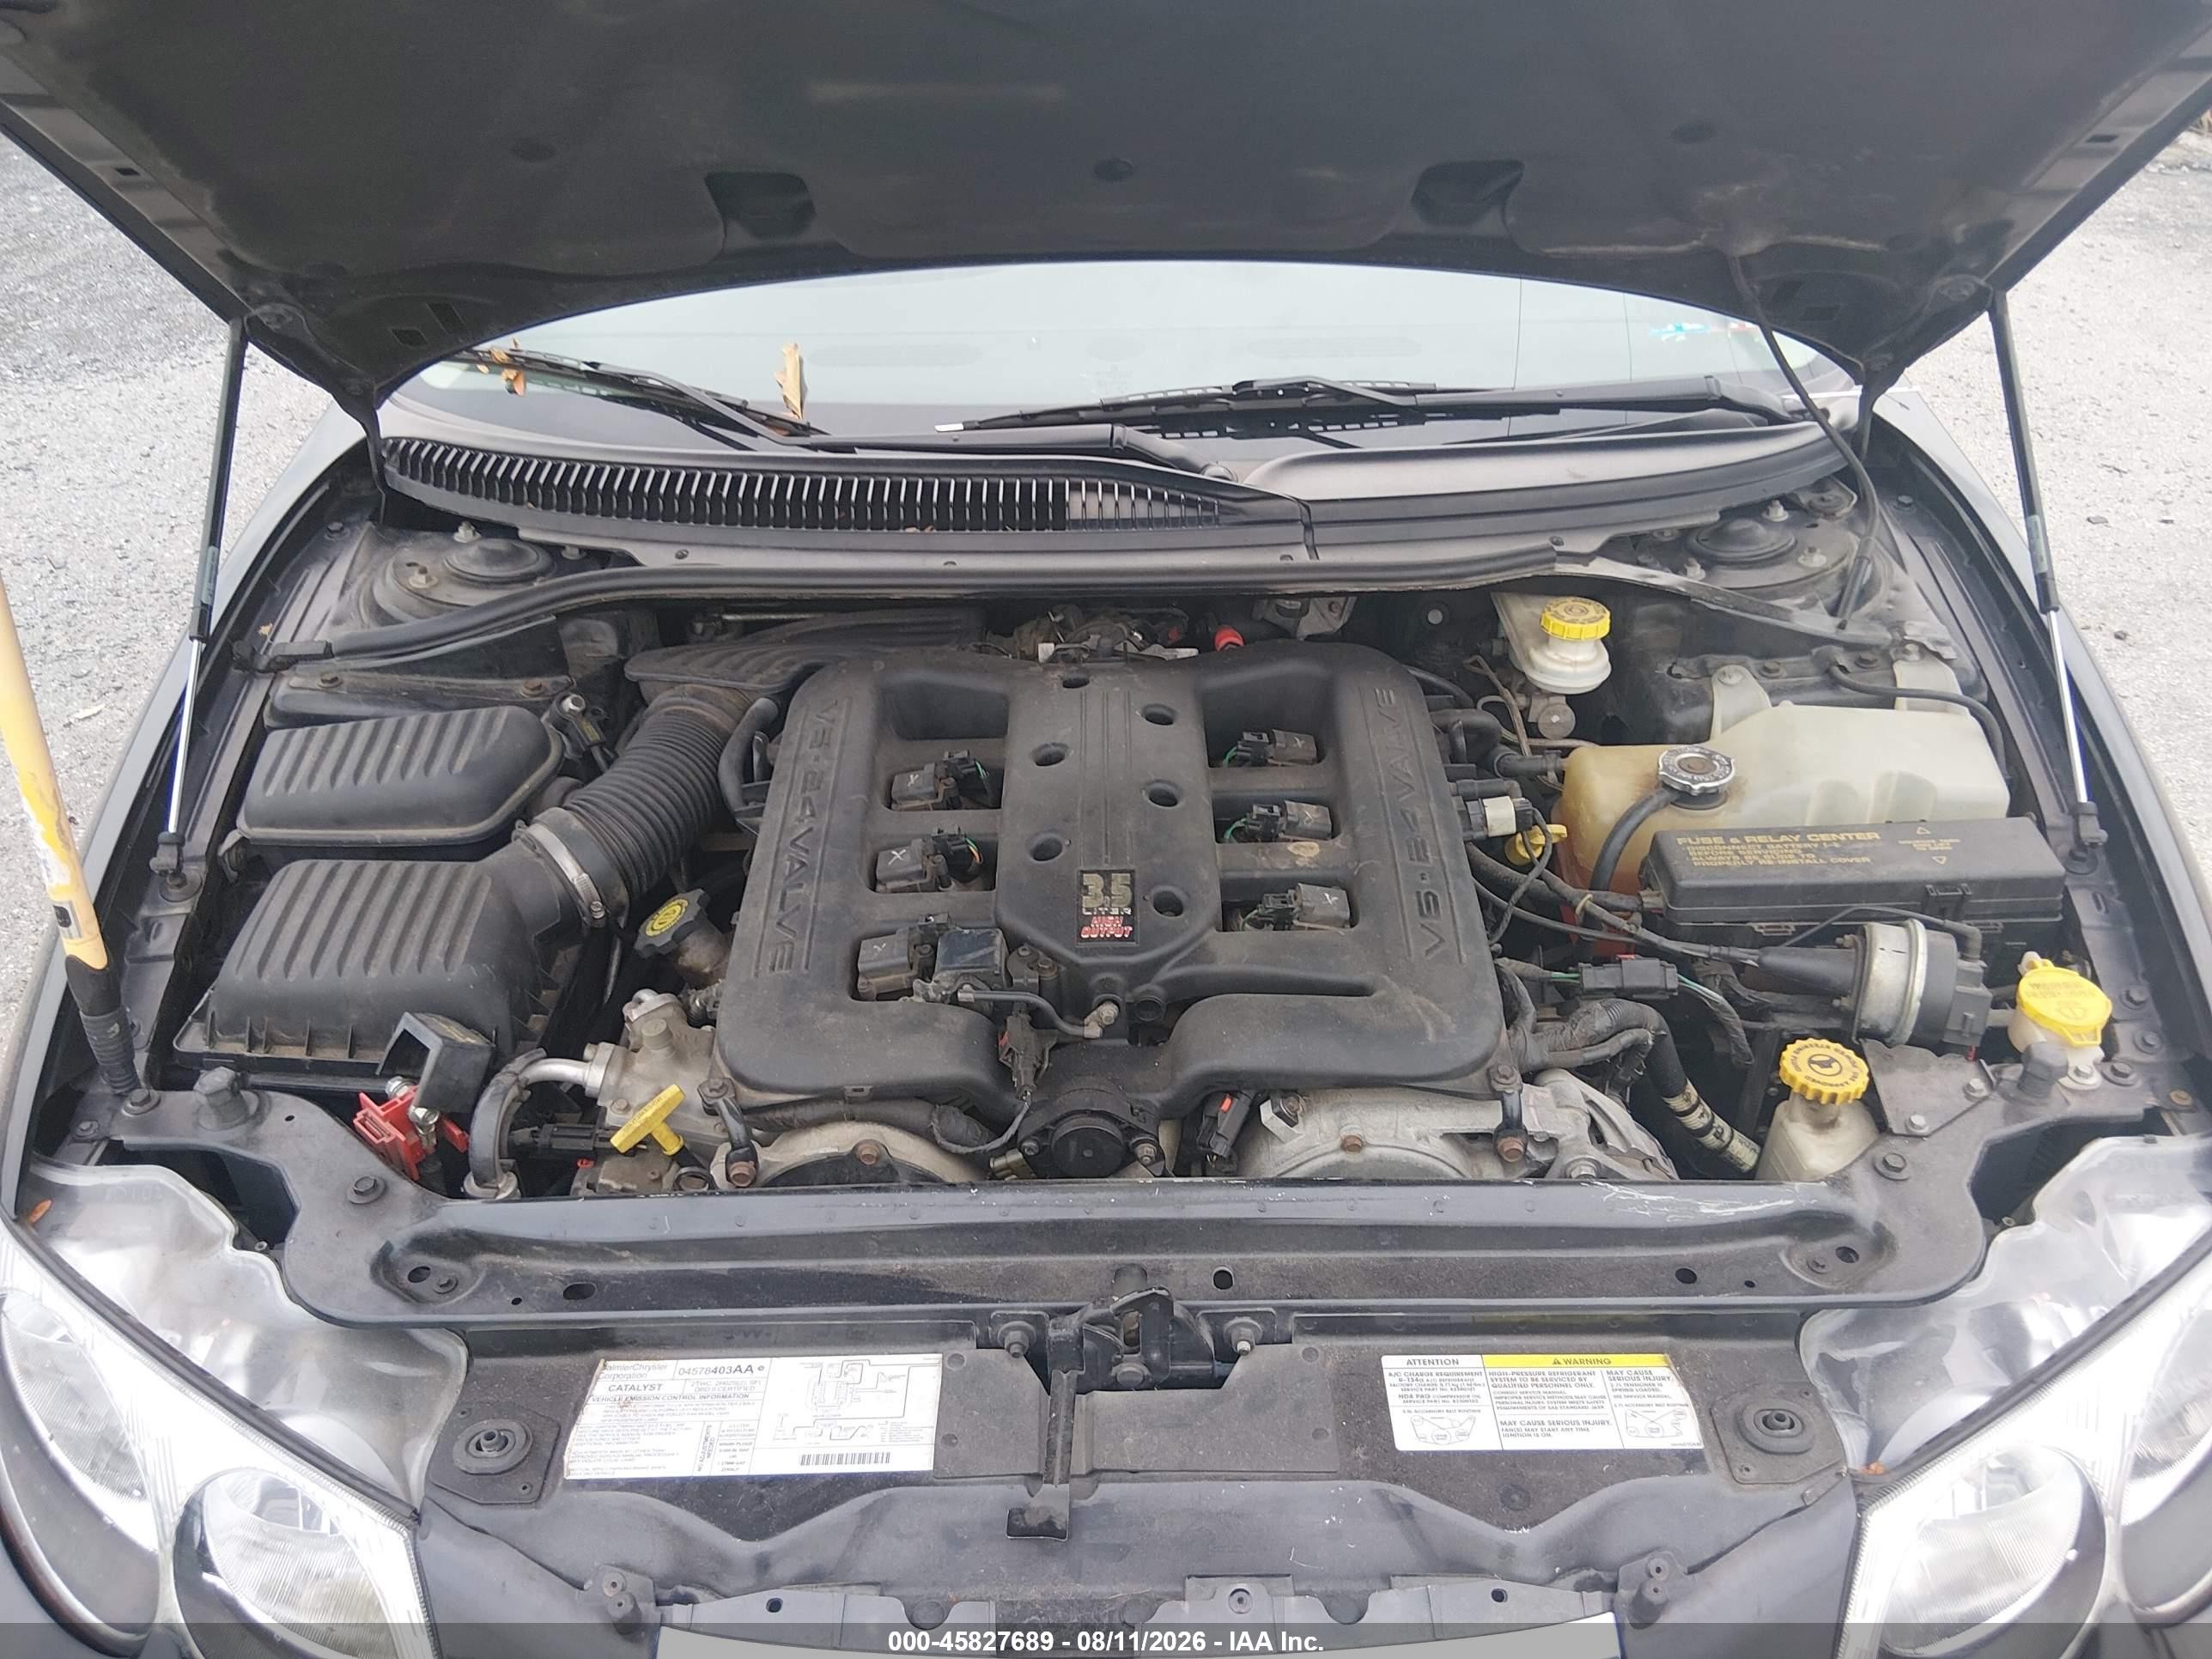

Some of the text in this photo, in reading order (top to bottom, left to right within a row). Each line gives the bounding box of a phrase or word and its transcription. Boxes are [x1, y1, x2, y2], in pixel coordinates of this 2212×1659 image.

[1676, 836, 1725, 845] FUSE
[1744, 835, 1801, 843] RELAY
[1807, 832, 1881, 842] CENTER
[1082, 873, 1133, 908] 3.5
[1082, 907, 1132, 915] LITER
[1080, 927, 1133, 939] OUTPUT
[678, 1364, 754, 1376] 04578403AA
[608, 1383, 662, 1392] CATALYST
